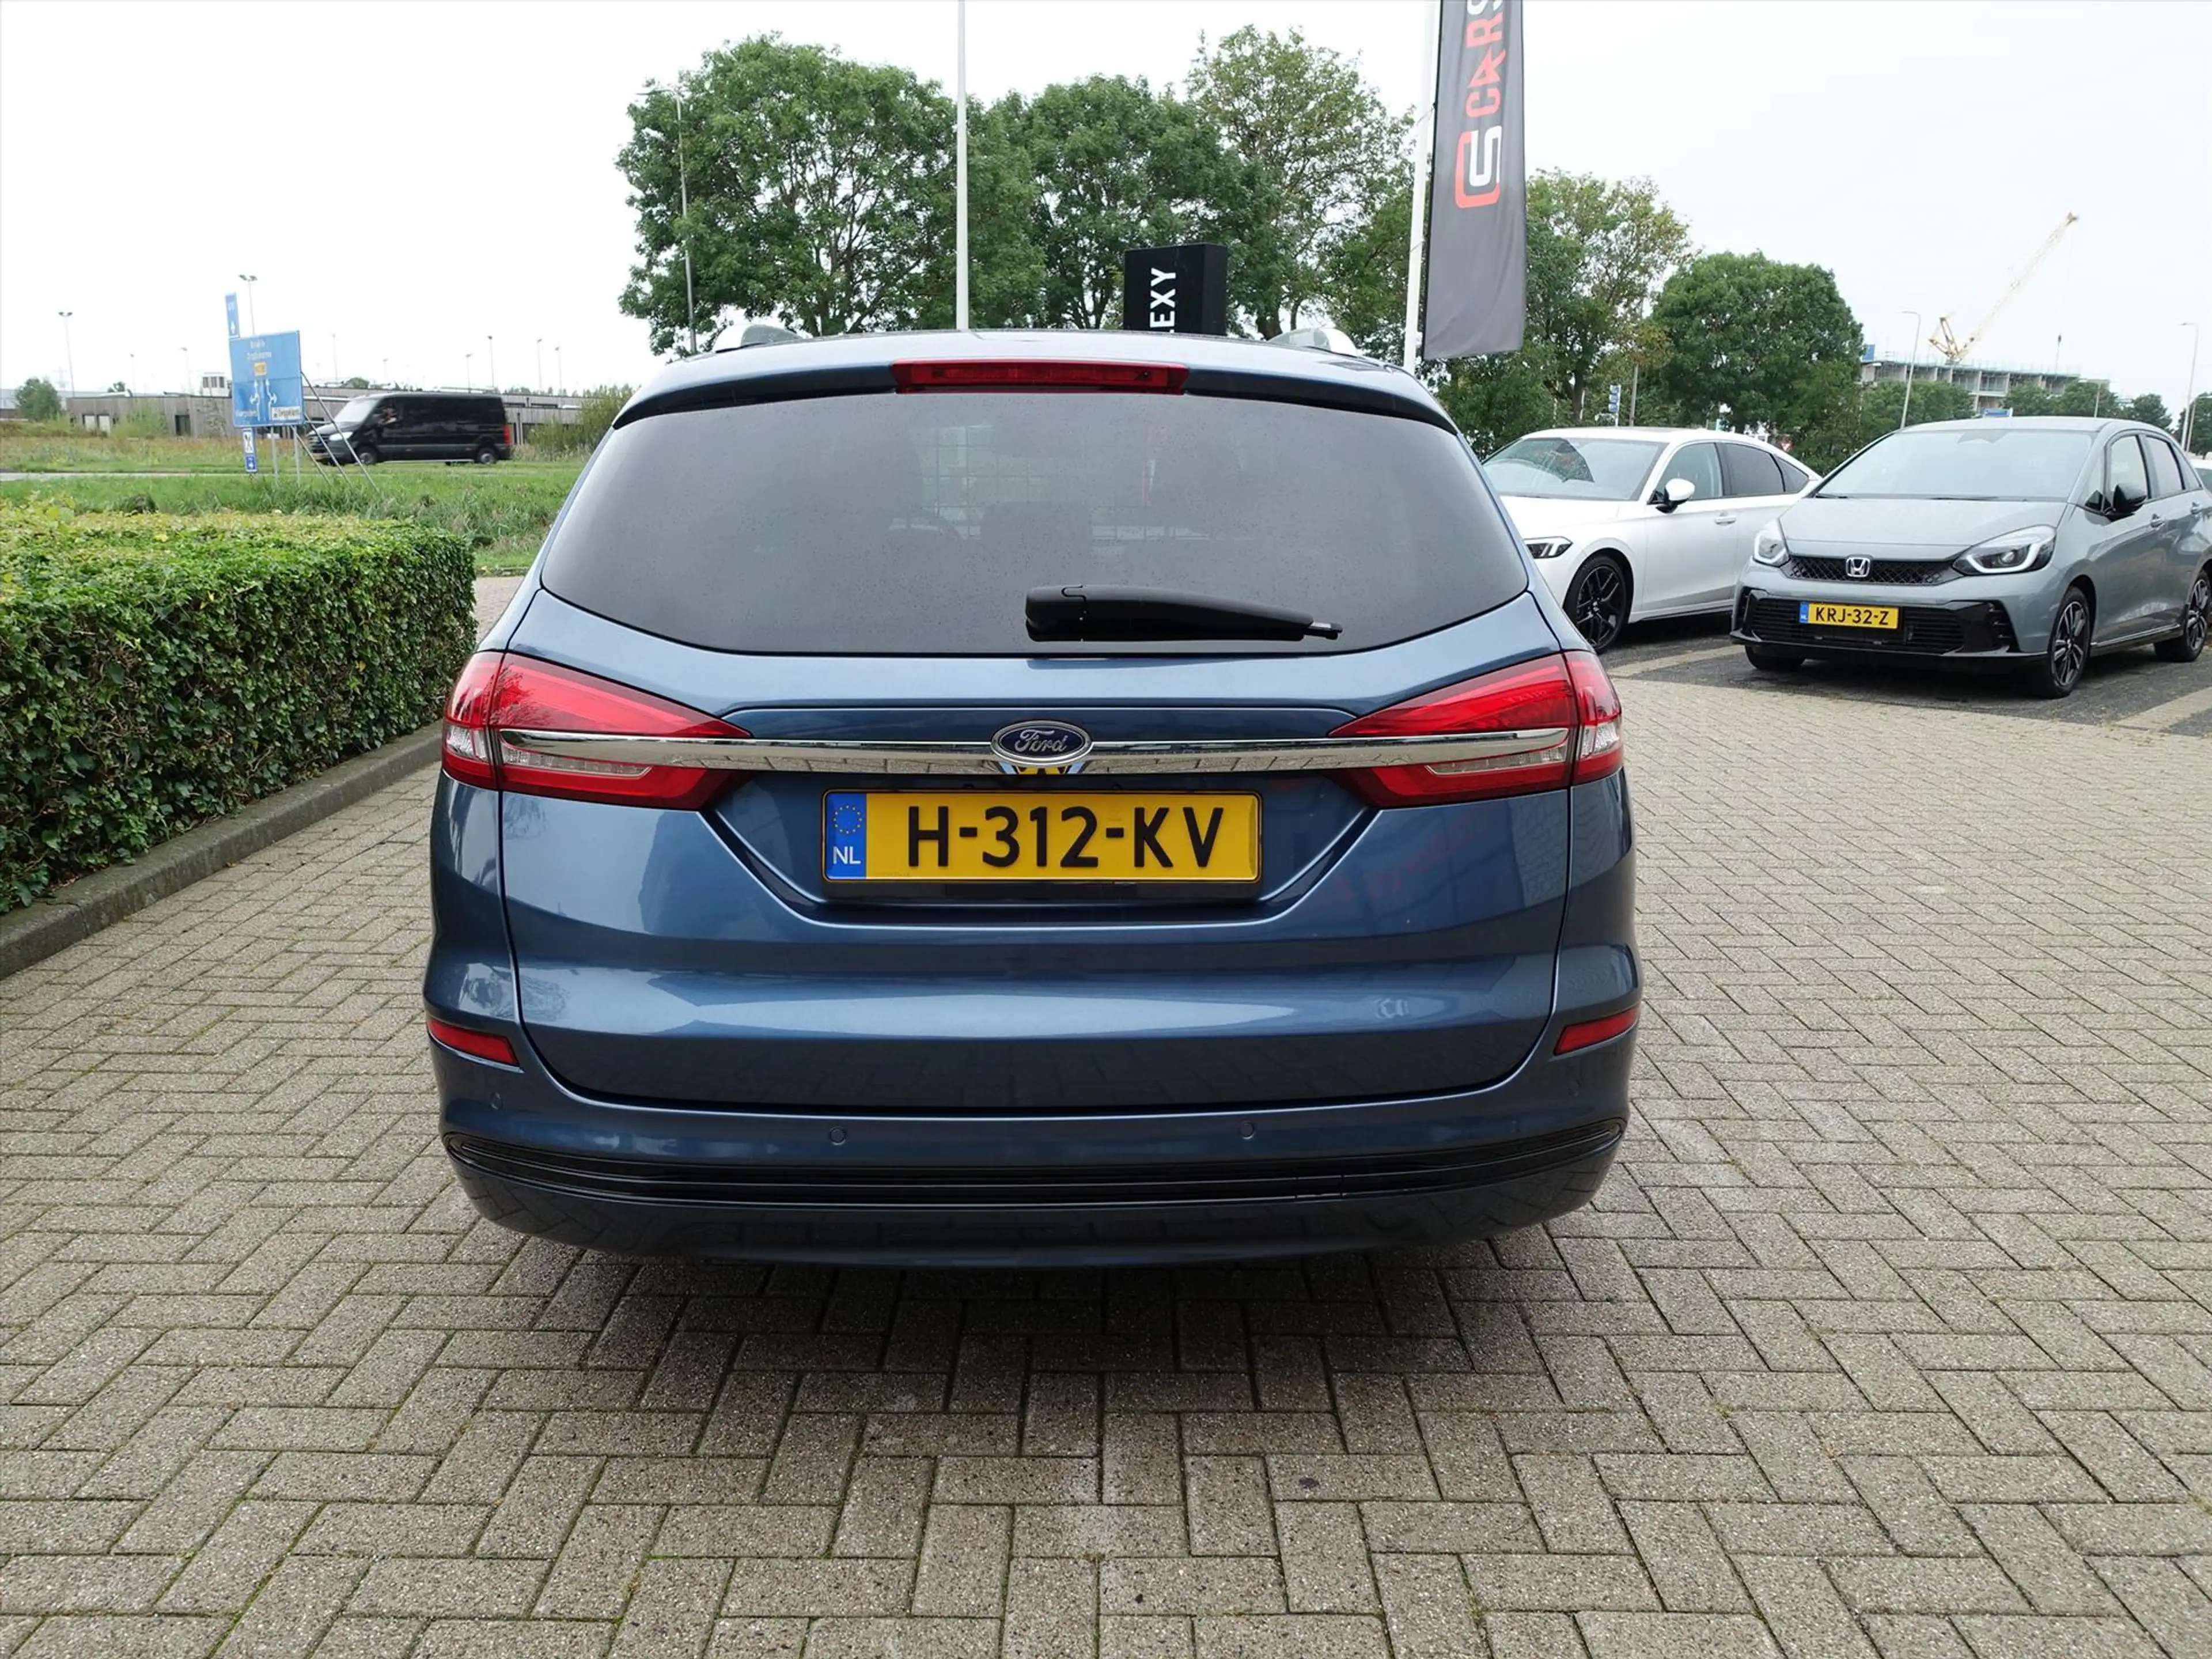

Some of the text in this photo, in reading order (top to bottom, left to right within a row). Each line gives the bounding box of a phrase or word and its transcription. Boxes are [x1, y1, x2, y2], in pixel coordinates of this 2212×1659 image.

[1150, 267, 1176, 334] EXY
[1815, 607, 1889, 626] KRJ-32-Z
[1014, 729, 1069, 752] Ford
[908, 806, 1224, 868] H-312-KV
[832, 846, 861, 865] NL
